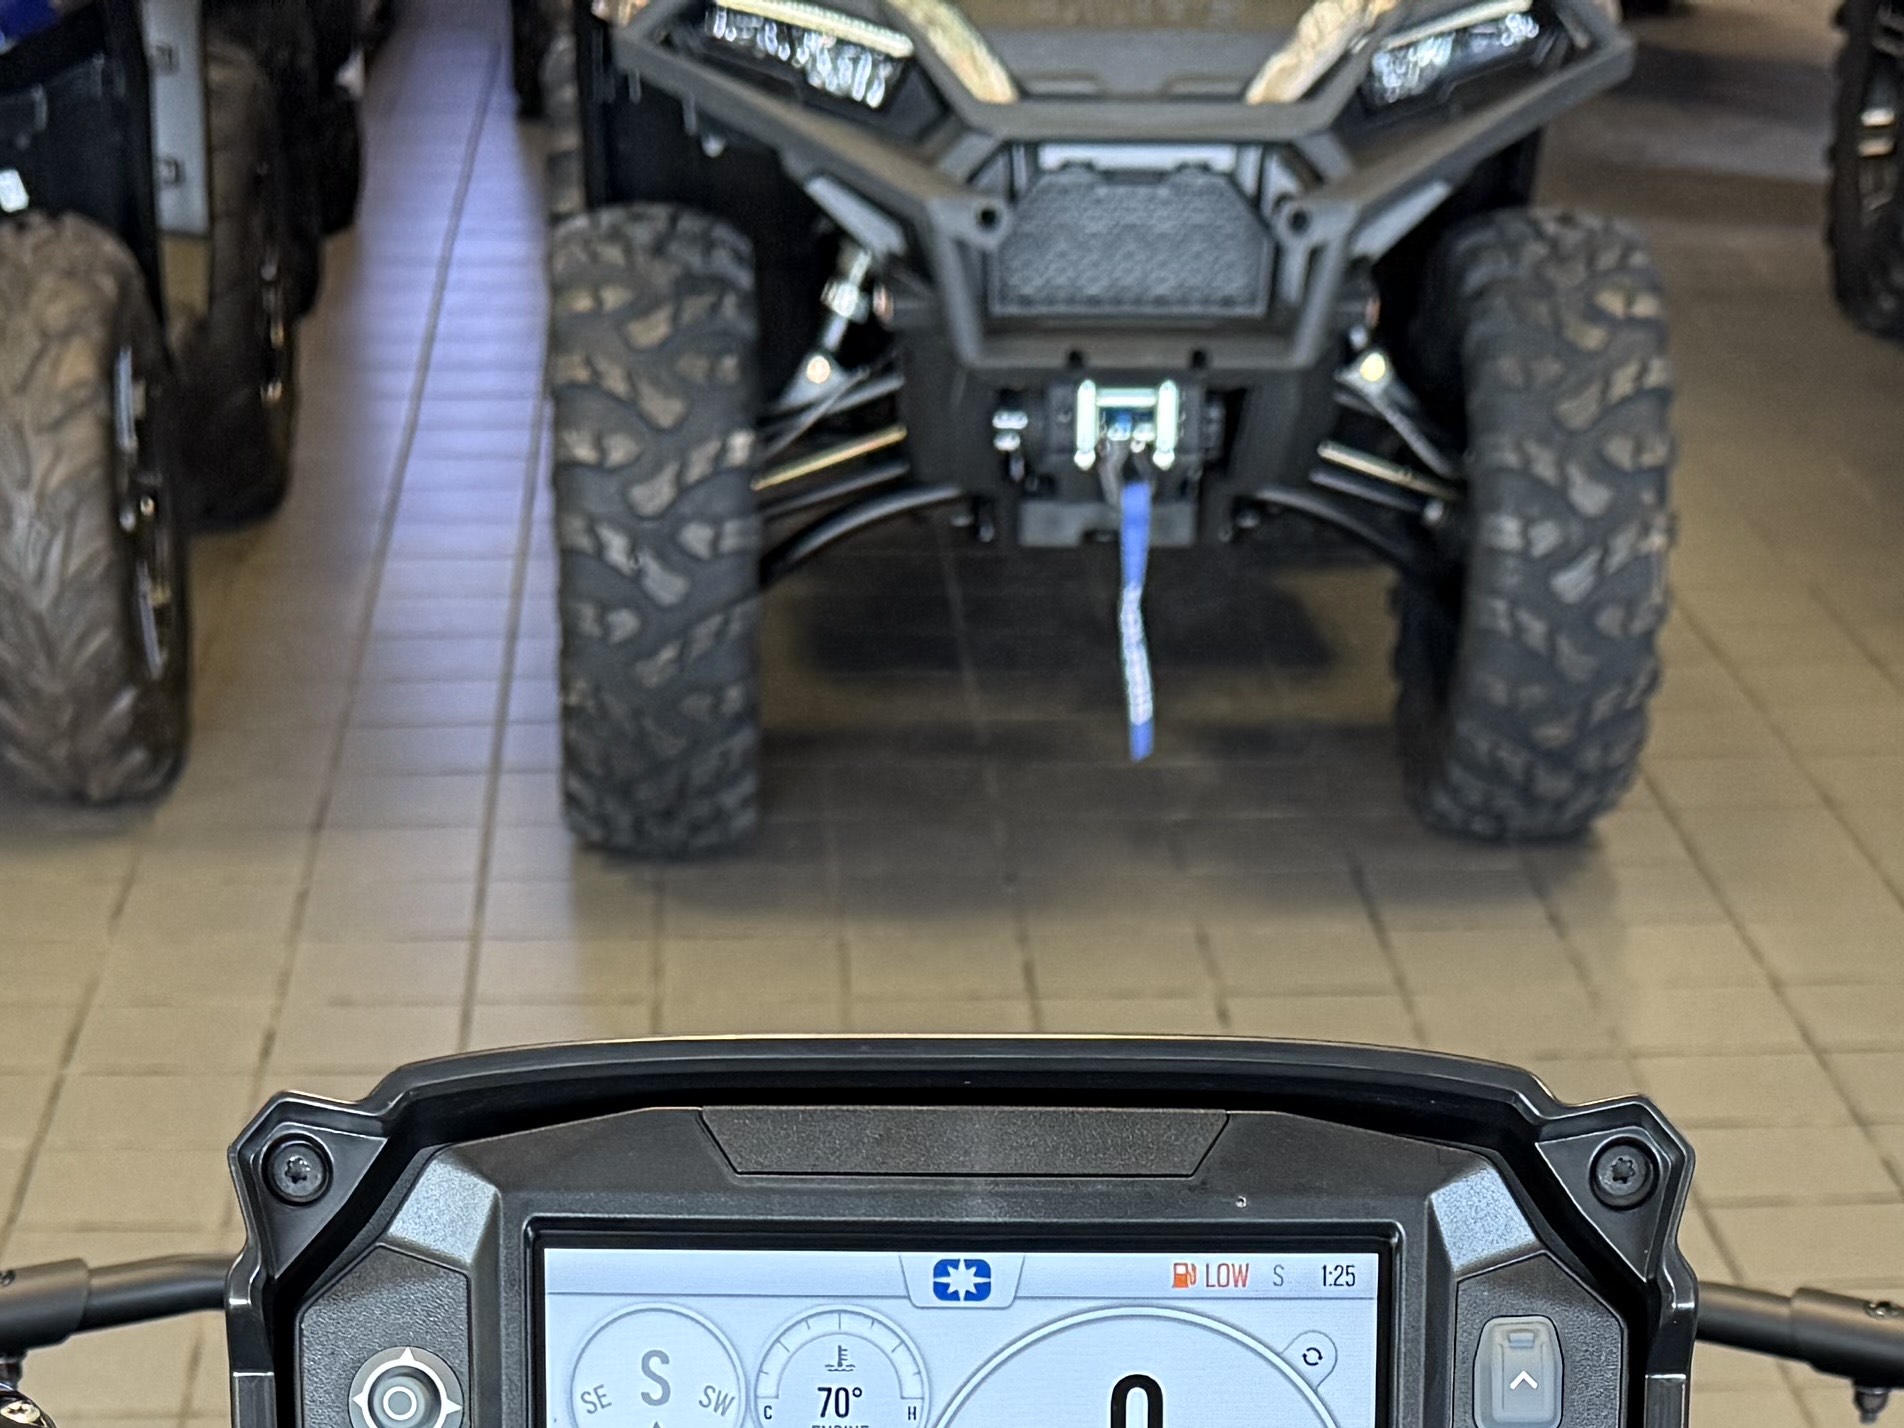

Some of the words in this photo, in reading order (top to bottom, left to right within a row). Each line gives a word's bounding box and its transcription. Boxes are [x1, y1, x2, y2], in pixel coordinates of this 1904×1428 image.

[1205, 1262, 1250, 1288] LOW
[1272, 1264, 1285, 1287] S
[1322, 1264, 1356, 1287] 1:25
[640, 1349, 671, 1407] S
[580, 1383, 613, 1415] SE
[698, 1384, 736, 1417] SW
[763, 1405, 773, 1420] C
[817, 1386, 863, 1419] 70°
[907, 1405, 917, 1421] H
